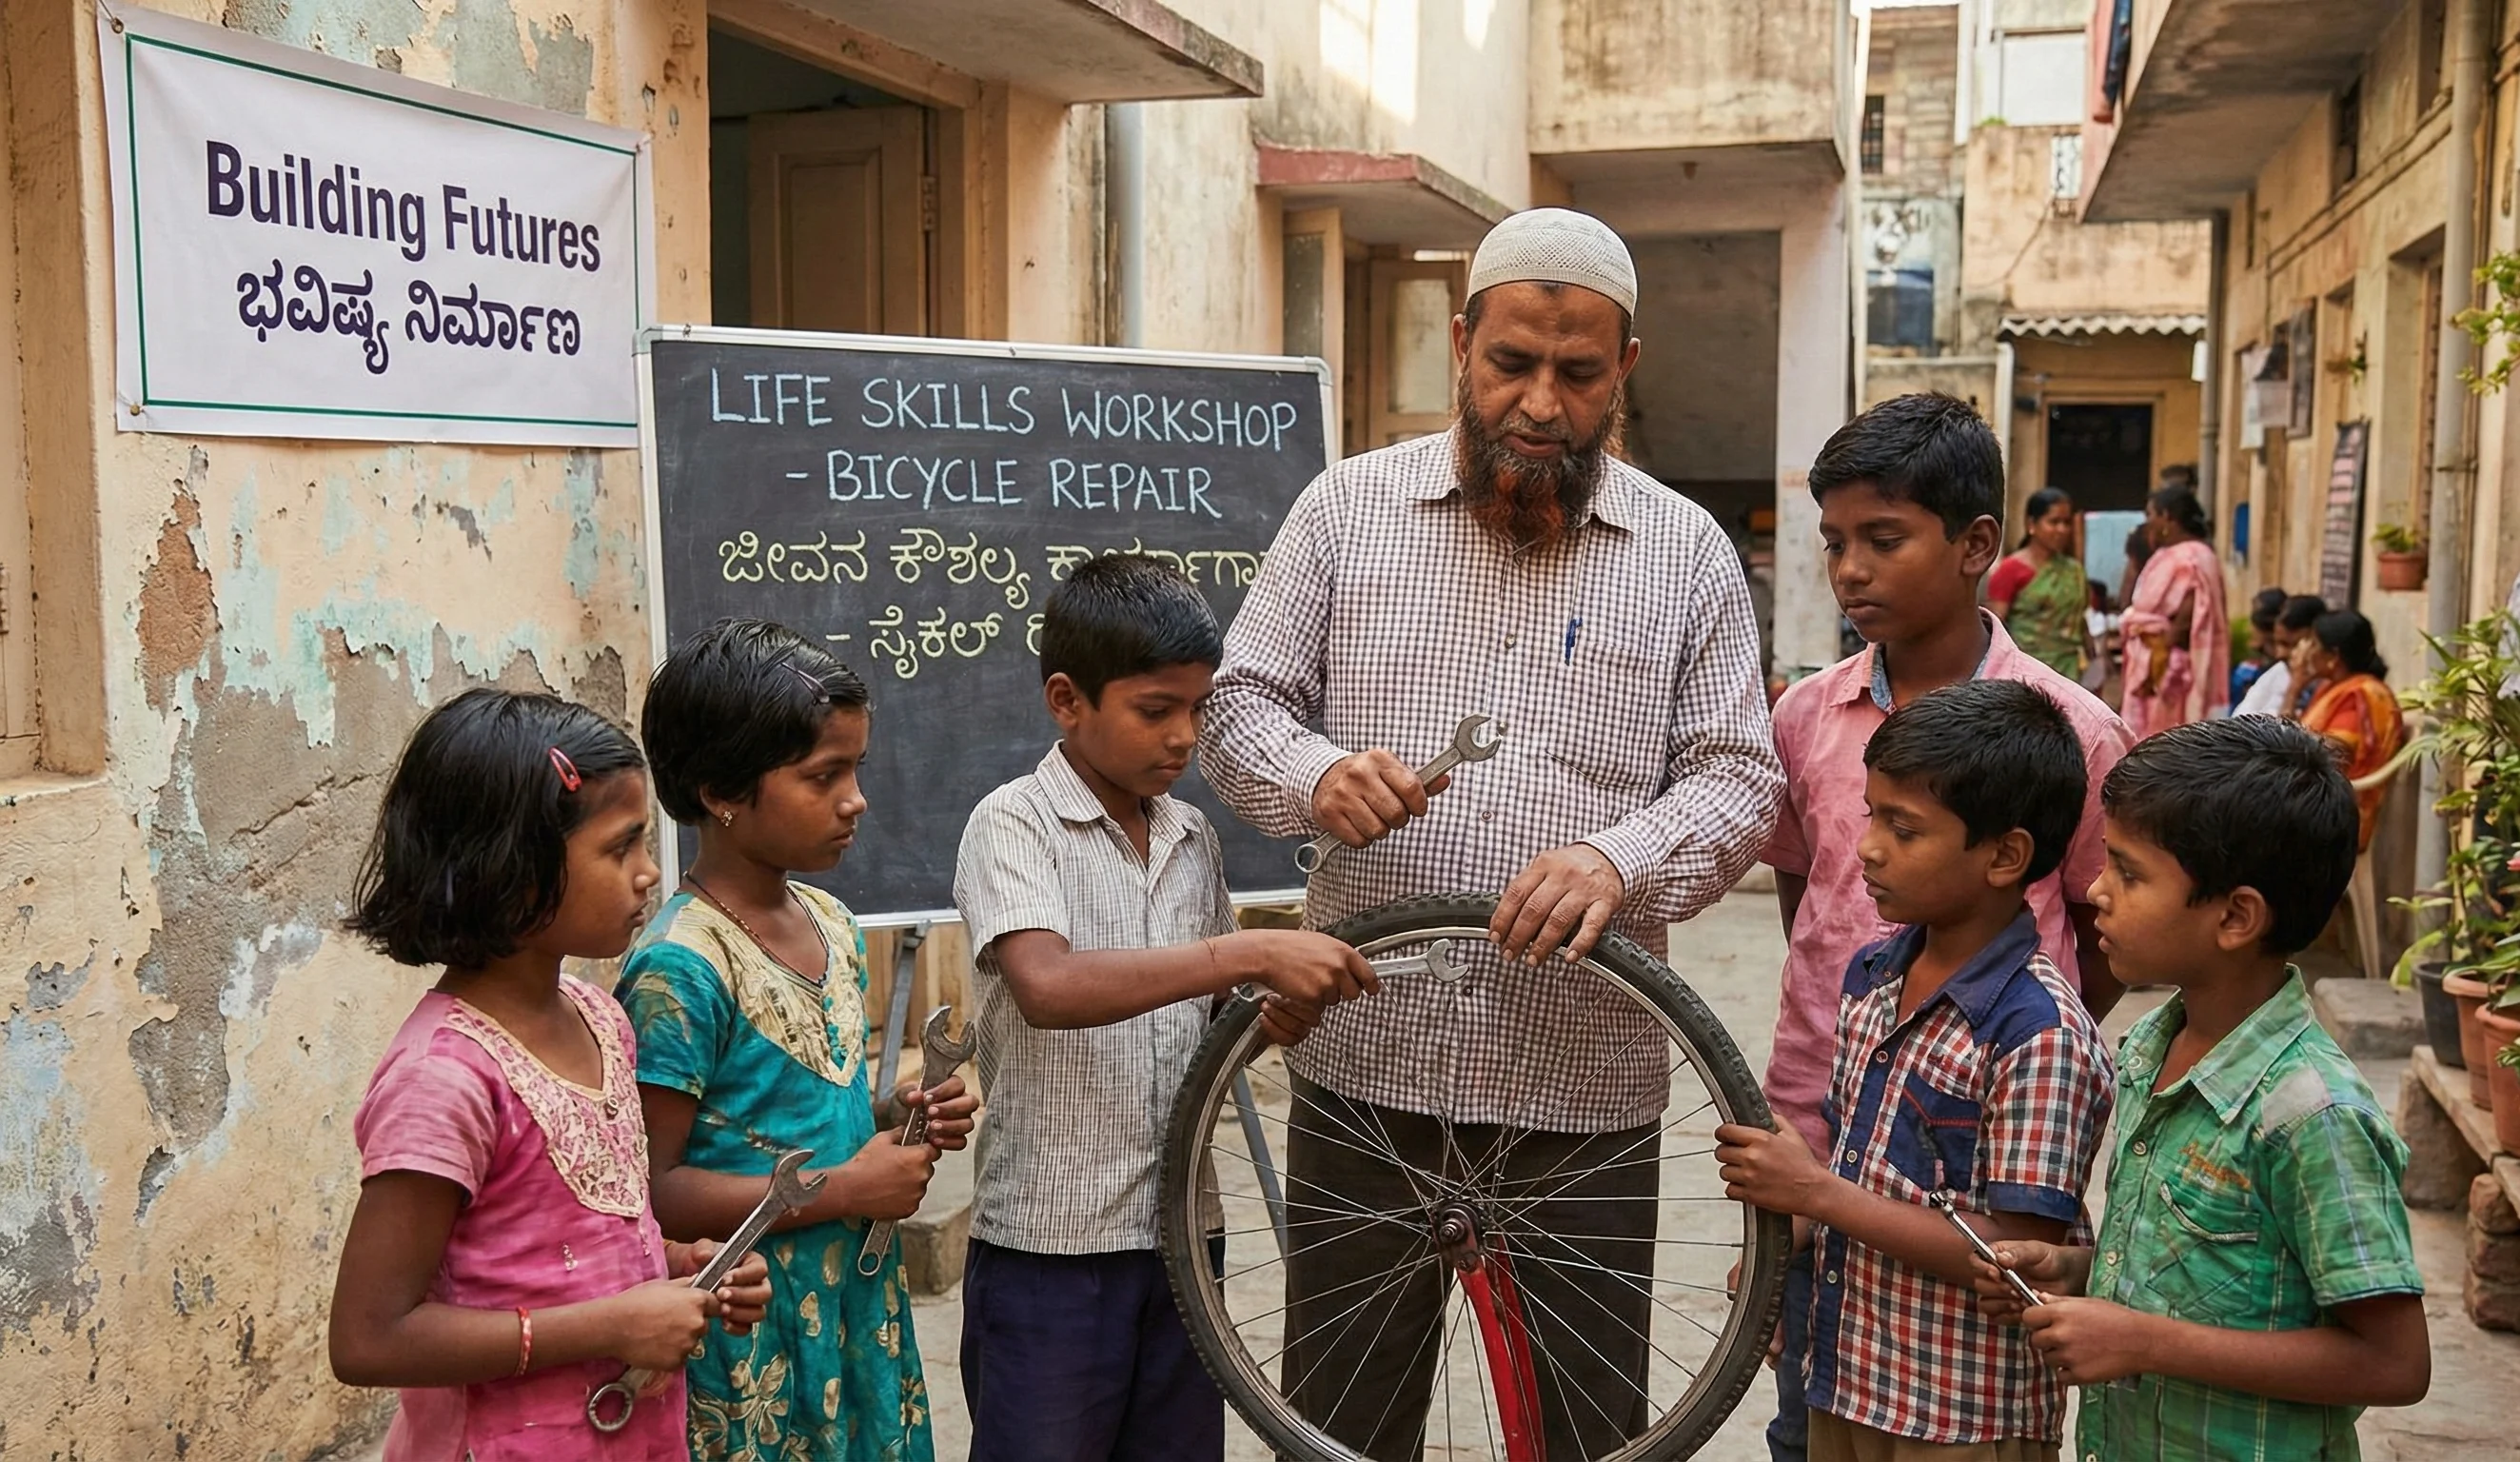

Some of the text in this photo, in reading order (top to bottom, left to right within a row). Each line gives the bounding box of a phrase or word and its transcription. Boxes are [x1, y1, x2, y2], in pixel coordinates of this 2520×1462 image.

[206, 140, 601, 272] Building Futures
[236, 258, 581, 375] ಭವಿಷ್ಯ ನಿರ್ಮಾಣ
[712, 367, 1298, 452] LIFE SKILLS WORKSHOP
[827, 449, 1023, 510] BICYCLE
[1050, 458, 1223, 519] REPAIR
[719, 529, 869, 584] ಜೀವನ
[890, 527, 1031, 610] ಕೌಶಲ್ಯ
[868, 604, 1004, 680] ಸೈಕಲ್
